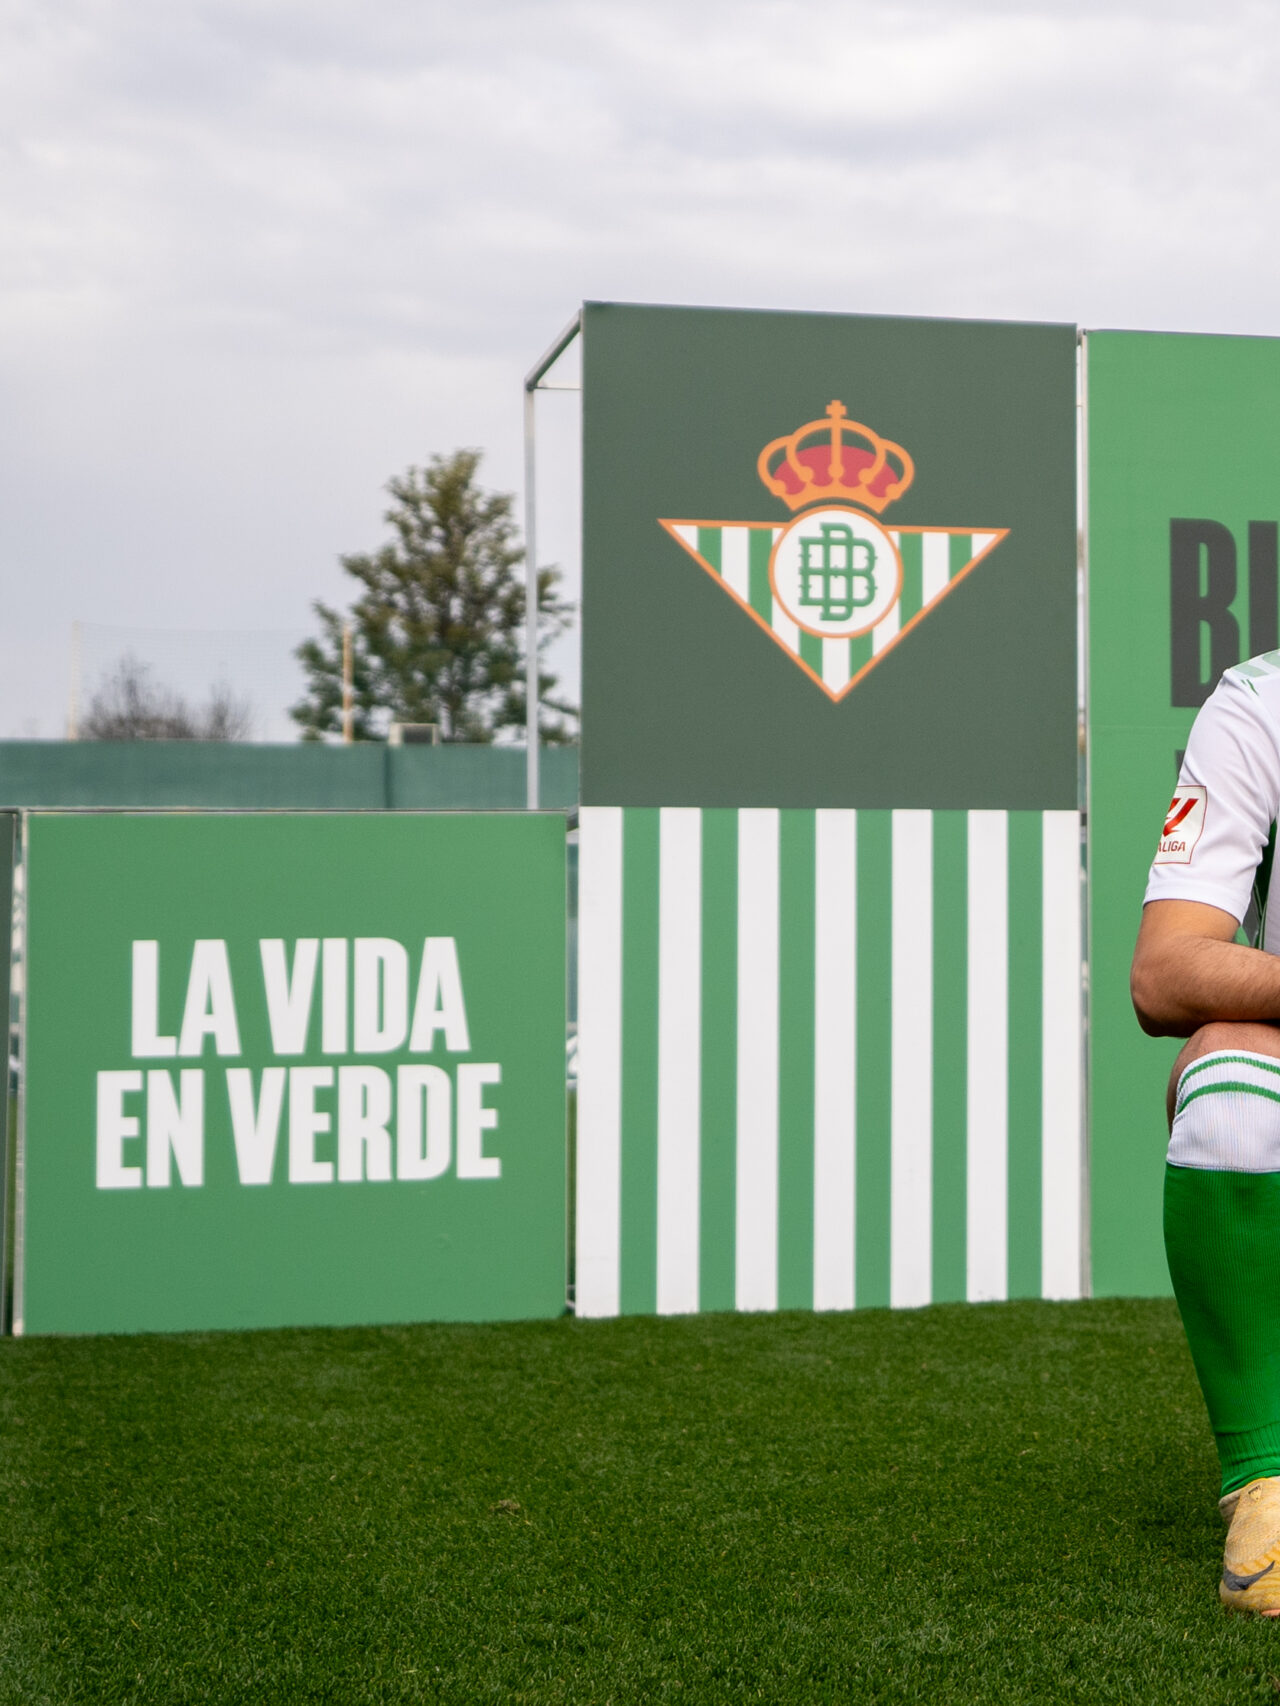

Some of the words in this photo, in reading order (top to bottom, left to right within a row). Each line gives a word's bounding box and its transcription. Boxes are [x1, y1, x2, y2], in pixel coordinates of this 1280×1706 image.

[131, 938, 242, 1058] LA
[259, 936, 471, 1055] VIDA
[96, 1068, 205, 1189] EN
[225, 1062, 501, 1185] VERDE
